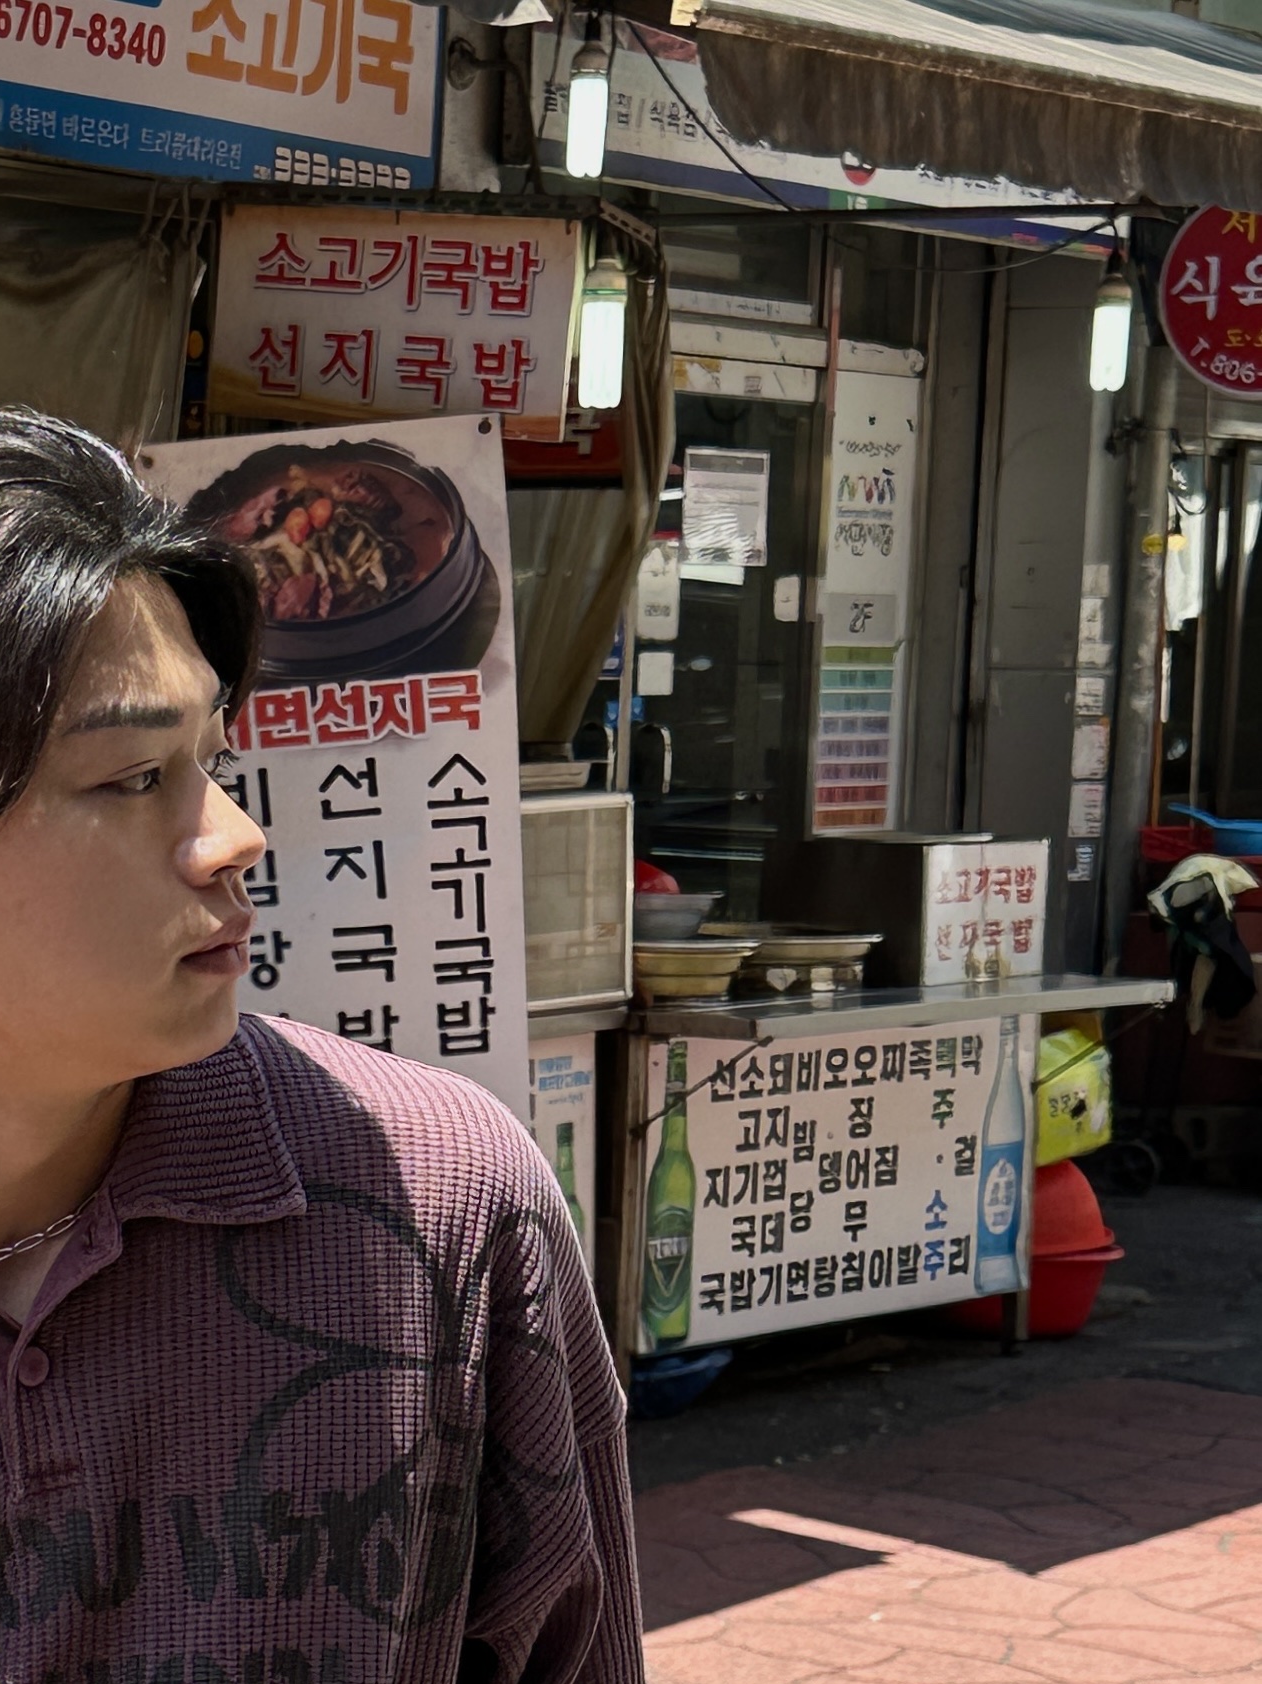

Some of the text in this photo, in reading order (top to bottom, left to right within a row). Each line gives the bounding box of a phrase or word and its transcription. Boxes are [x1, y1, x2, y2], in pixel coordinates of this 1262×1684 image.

[254, 233, 538, 312] 소고기국밥
[249, 324, 531, 410] 선지국밥
[427, 753, 495, 1057] 소고기국밥
